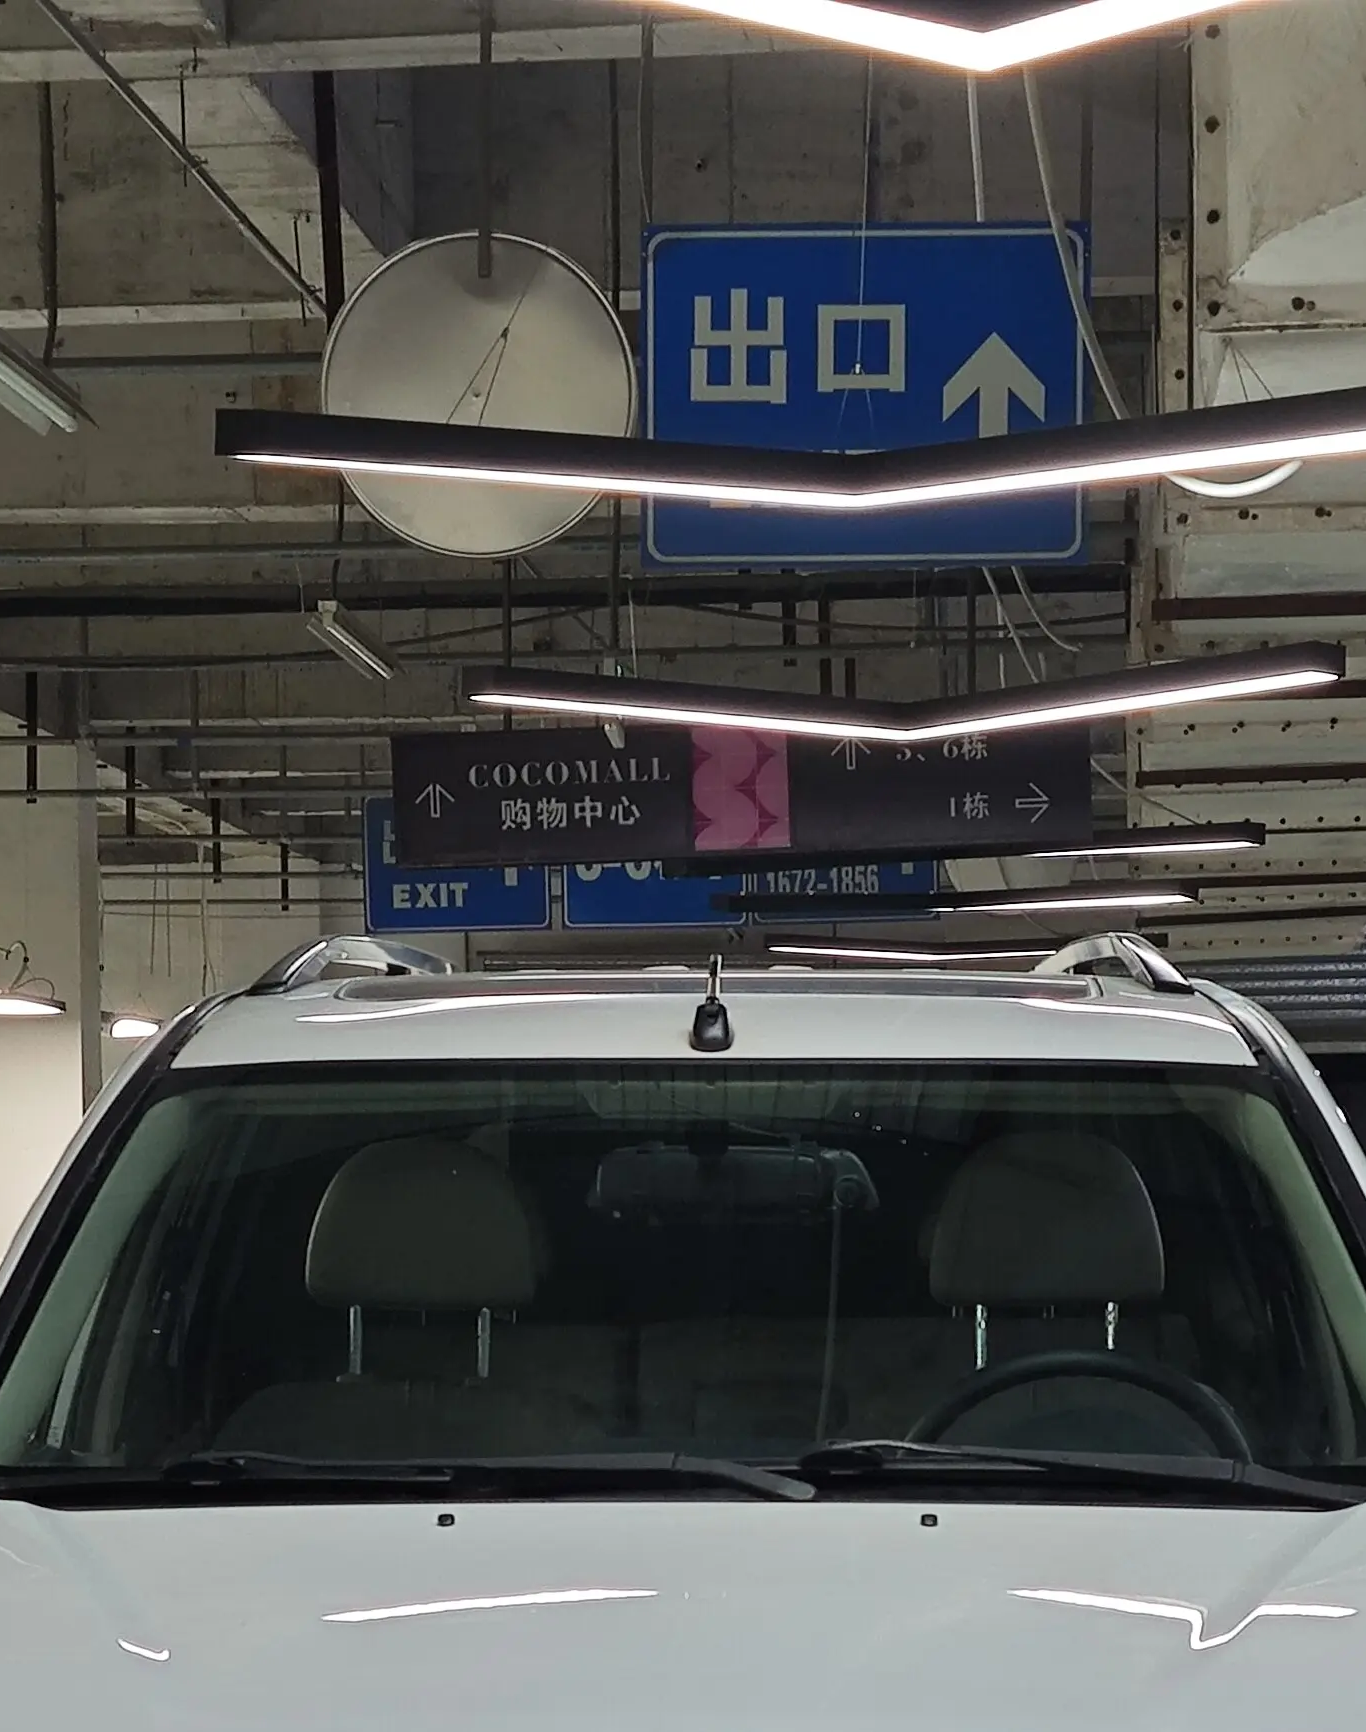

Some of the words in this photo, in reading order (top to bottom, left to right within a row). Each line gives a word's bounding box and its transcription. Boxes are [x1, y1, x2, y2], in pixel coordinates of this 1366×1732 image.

[690, 288, 906, 404] 出口
[468, 757, 671, 788] COCOMALL
[501, 795, 641, 831] 购物中心
[949, 792, 990, 820] 1栋
[392, 882, 468, 909] EXIT
